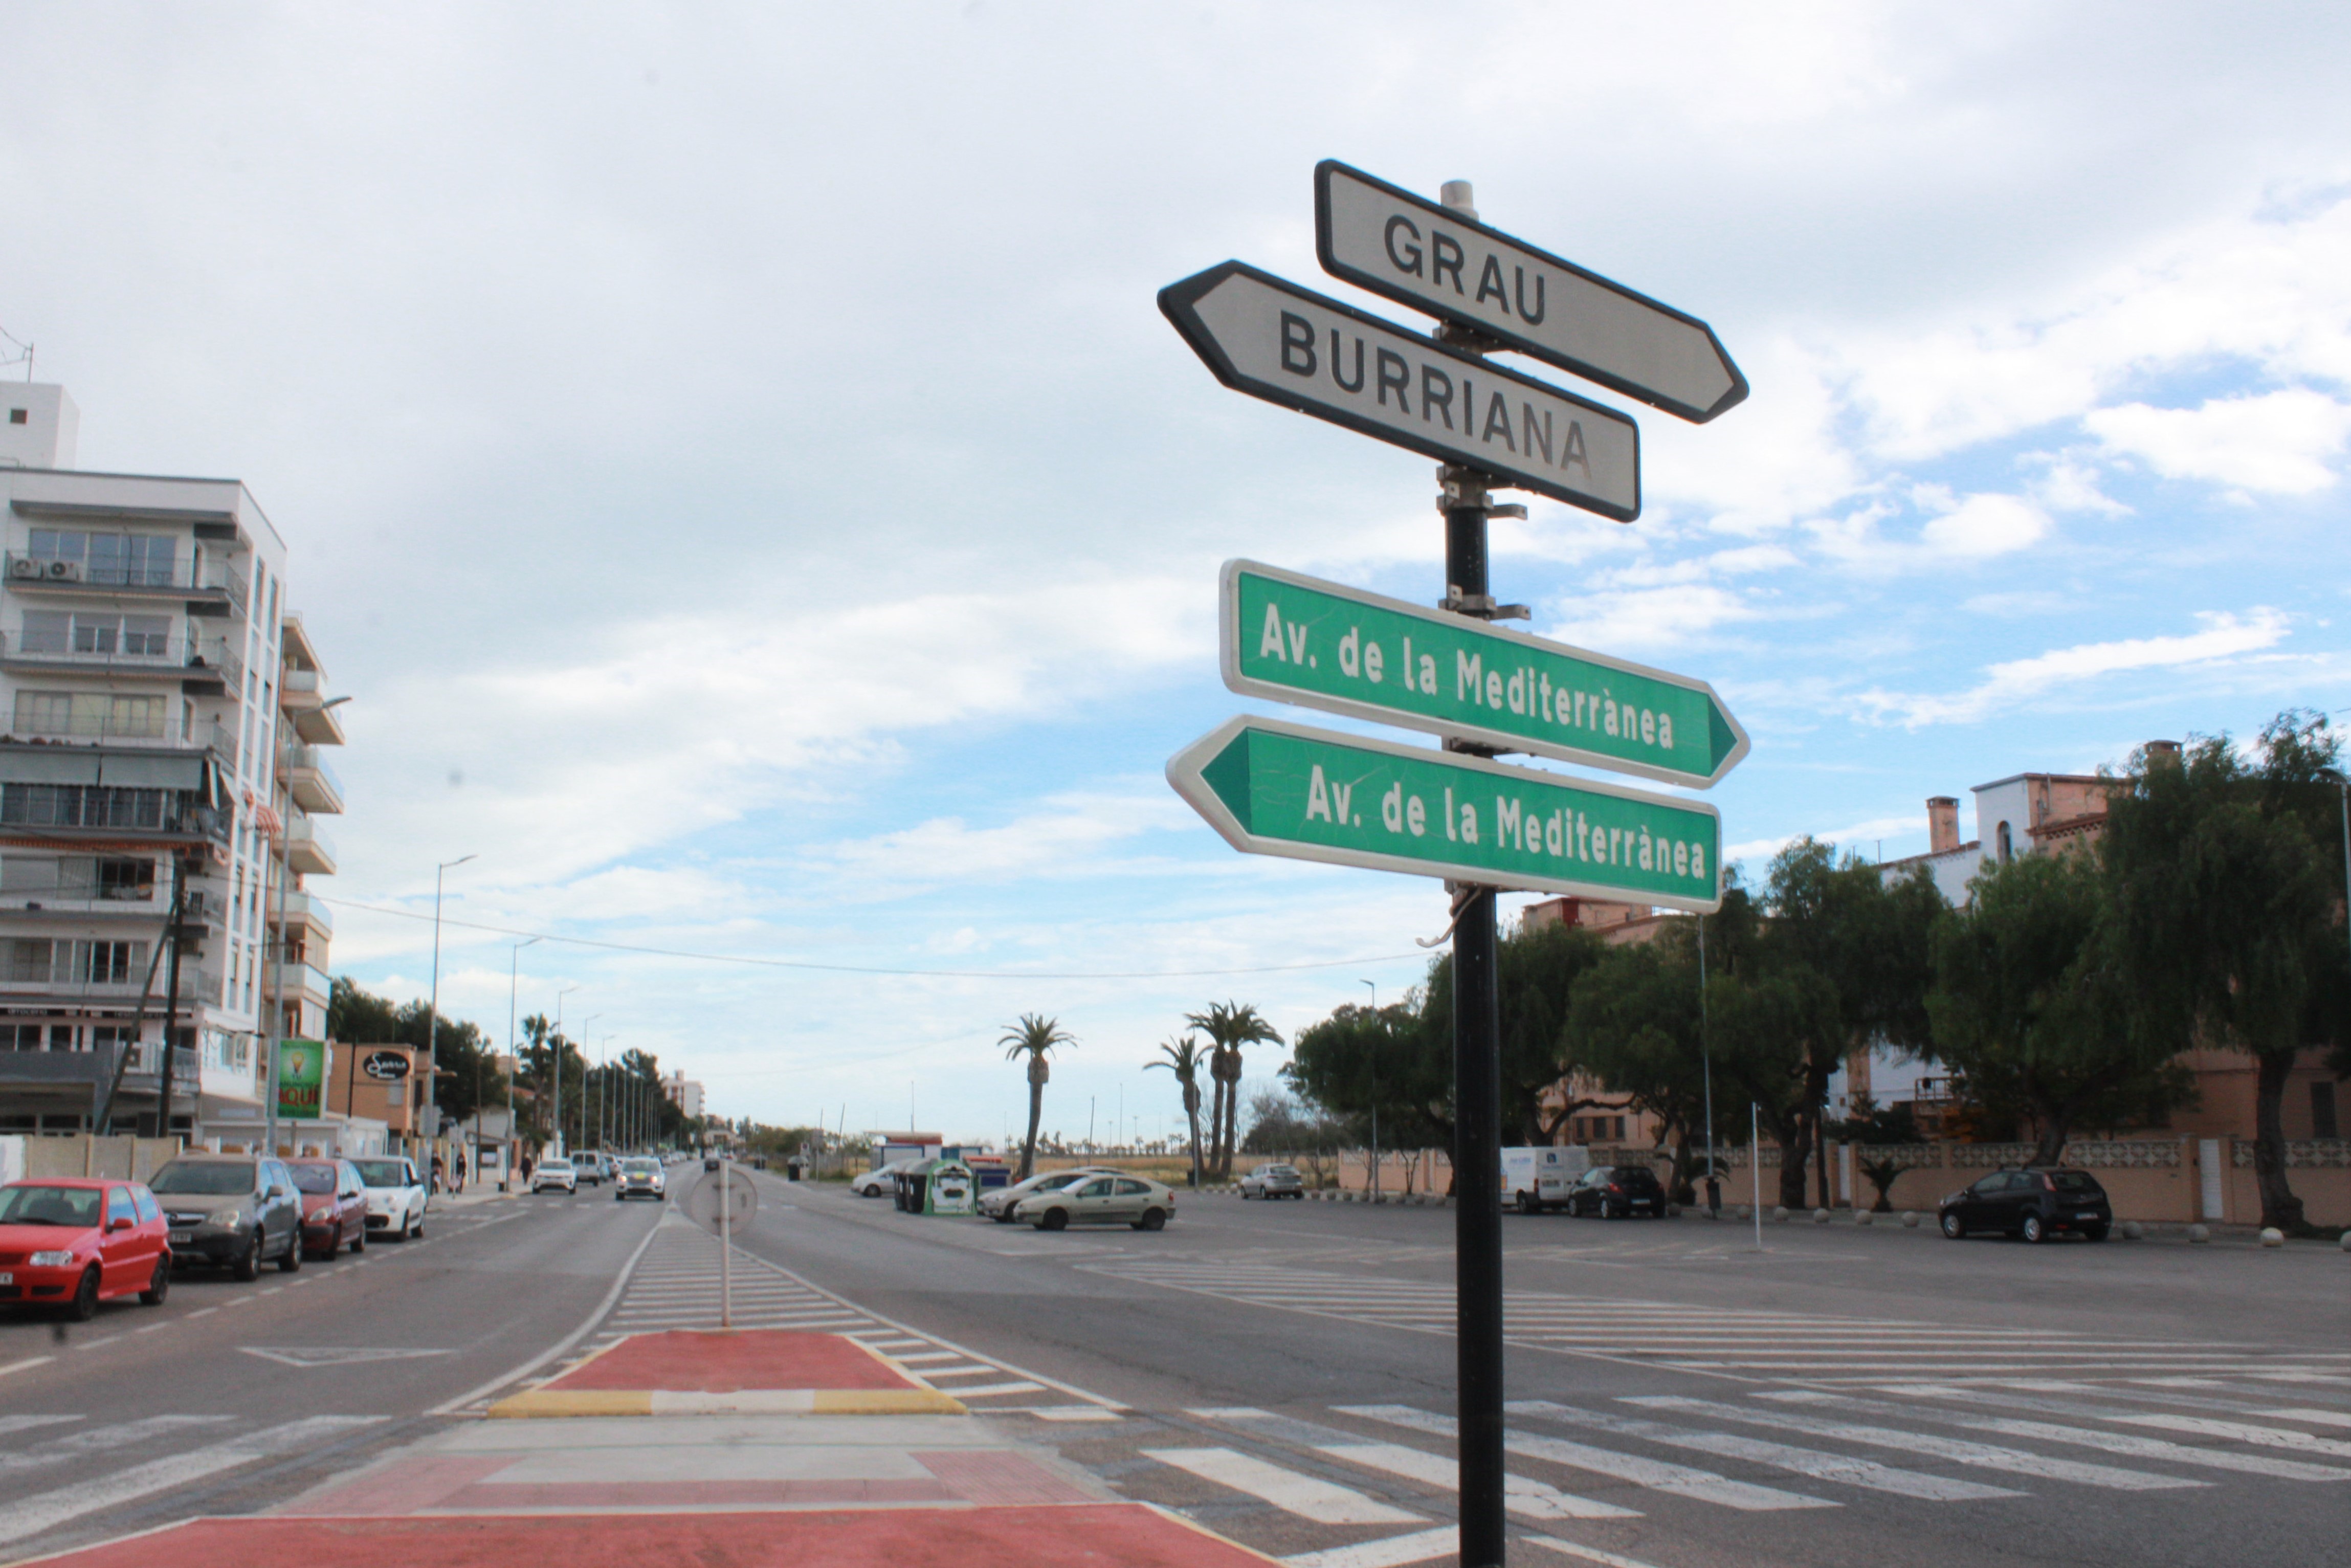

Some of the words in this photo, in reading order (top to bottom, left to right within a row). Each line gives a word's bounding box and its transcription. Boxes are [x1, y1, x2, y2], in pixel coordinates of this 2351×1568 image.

[1384, 213, 1545, 326] GRAU
[1280, 310, 1591, 478] BURRIANA
[1260, 603, 1317, 668] Av.
[1339, 627, 1384, 682] de
[1404, 637, 1438, 695] la
[1457, 650, 1674, 748] Mediterrànea
[1306, 765, 1361, 827] Av.
[1382, 782, 1426, 836] de
[1445, 787, 1478, 844] la
[1497, 796, 1705, 878] Mediterrànea
